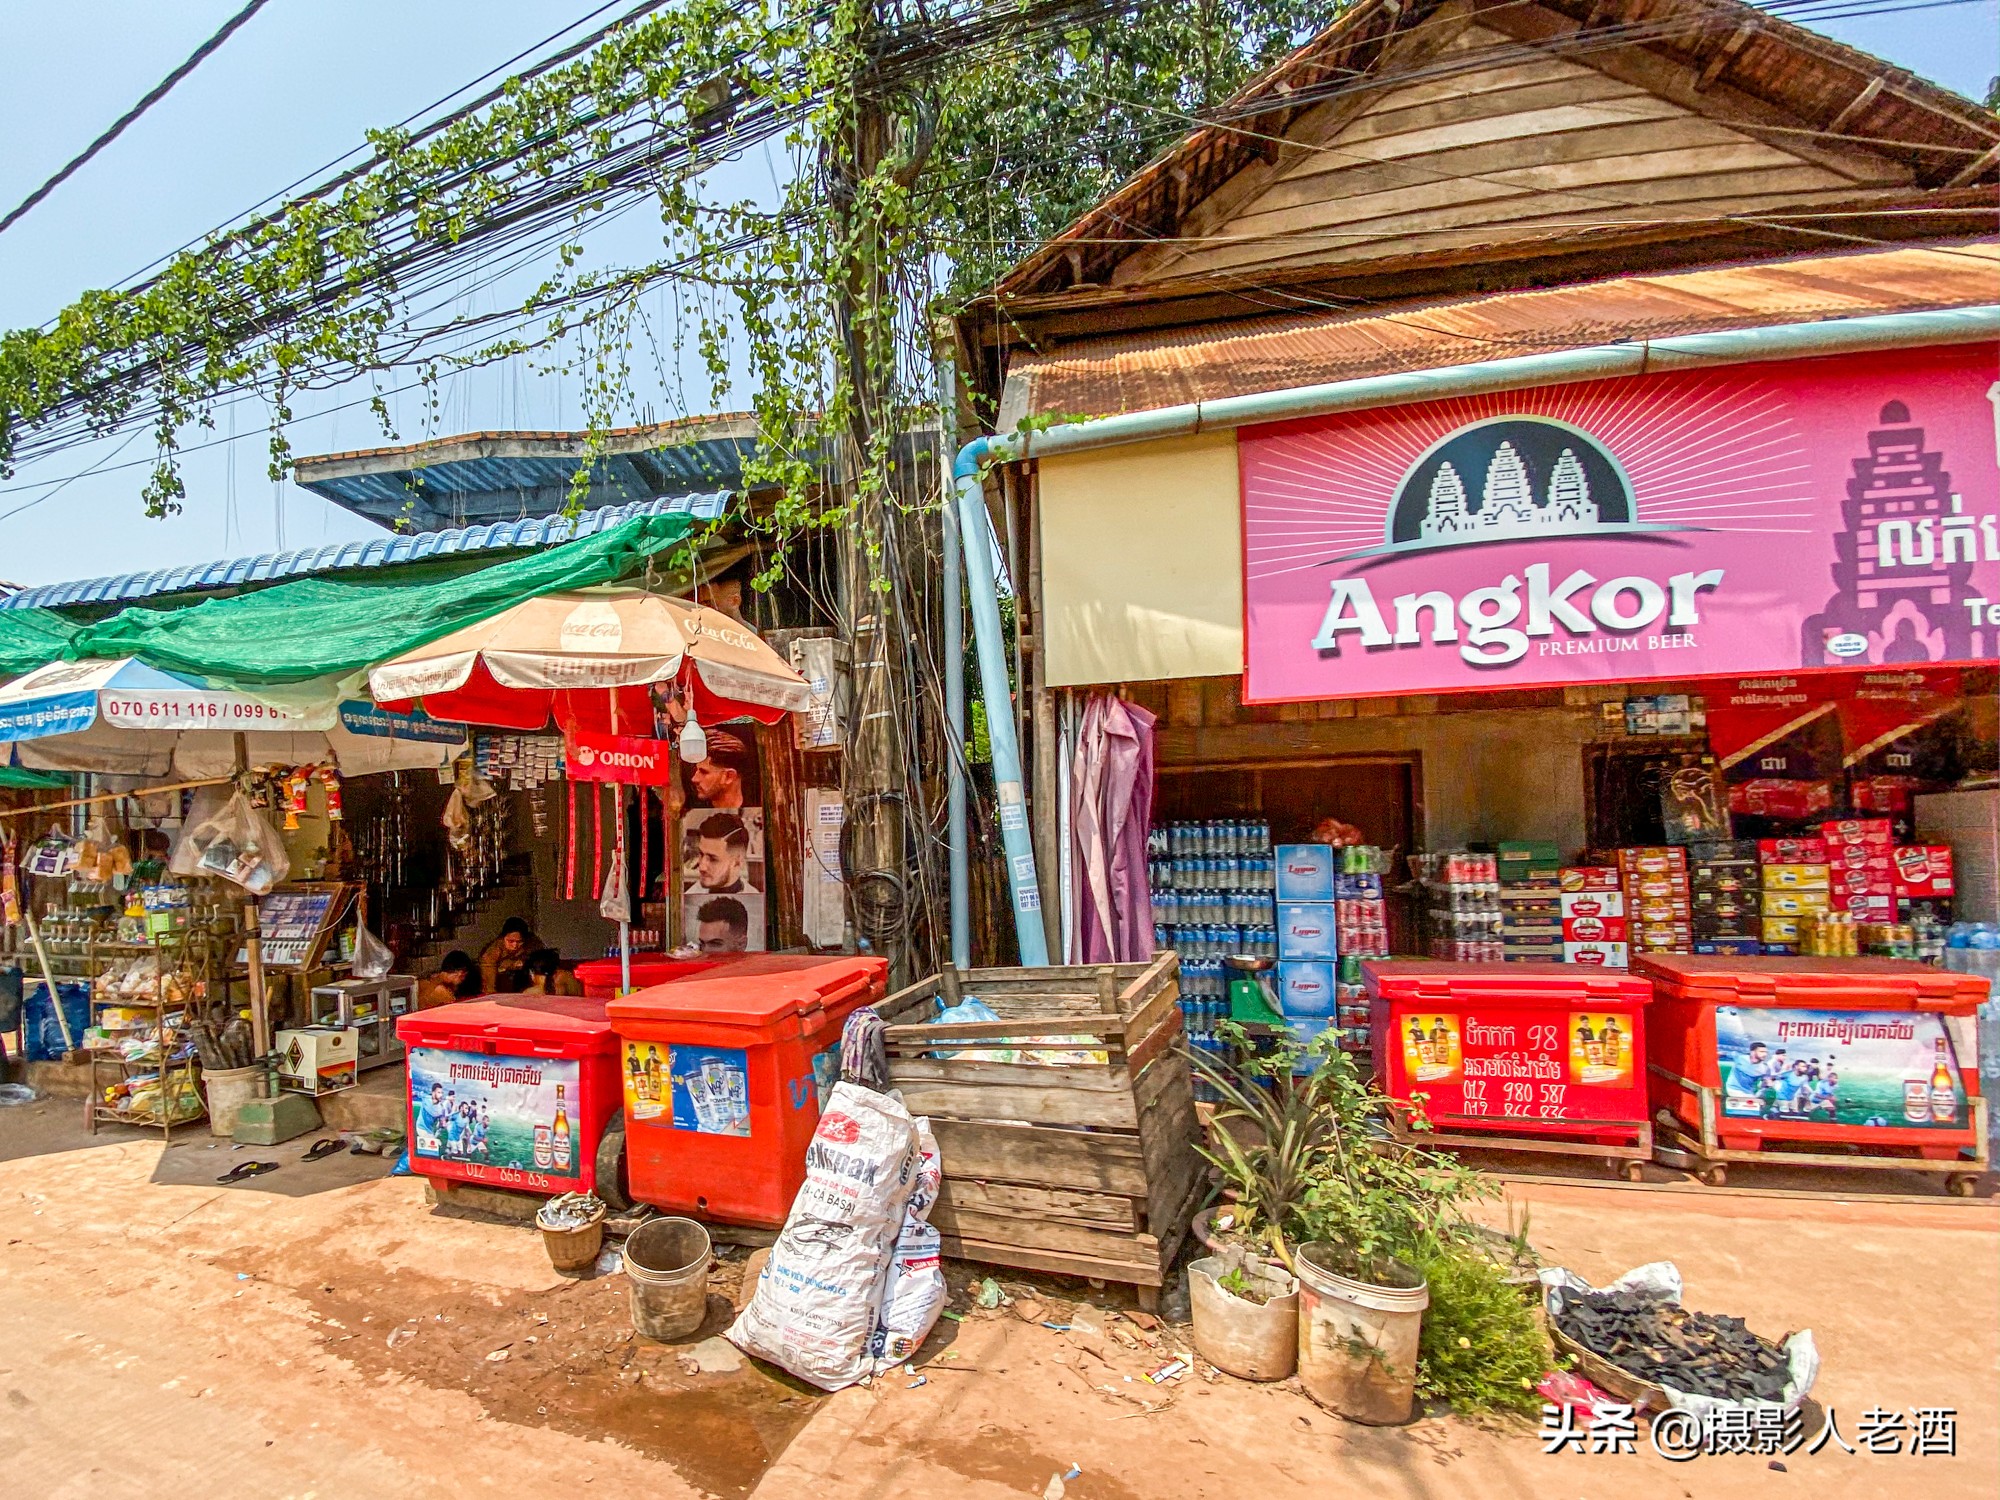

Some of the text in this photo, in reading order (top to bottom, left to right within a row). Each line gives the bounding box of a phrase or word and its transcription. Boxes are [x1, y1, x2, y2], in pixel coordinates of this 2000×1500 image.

[1312, 562, 1725, 665] Angkor
[1539, 632, 1698, 657] PREMIUM BEER
[110, 701, 143, 716] 070
[150, 702, 180, 716] 611
[188, 702, 217, 718] 116
[234, 704, 263, 718] 099
[600, 751, 654, 769] ORION
[1527, 1025, 1558, 1051] 98
[449, 1060, 542, 1089] ពុះពារដើម្បីជោគជ័យ
[1463, 1080, 1566, 1104] 012 980 587
